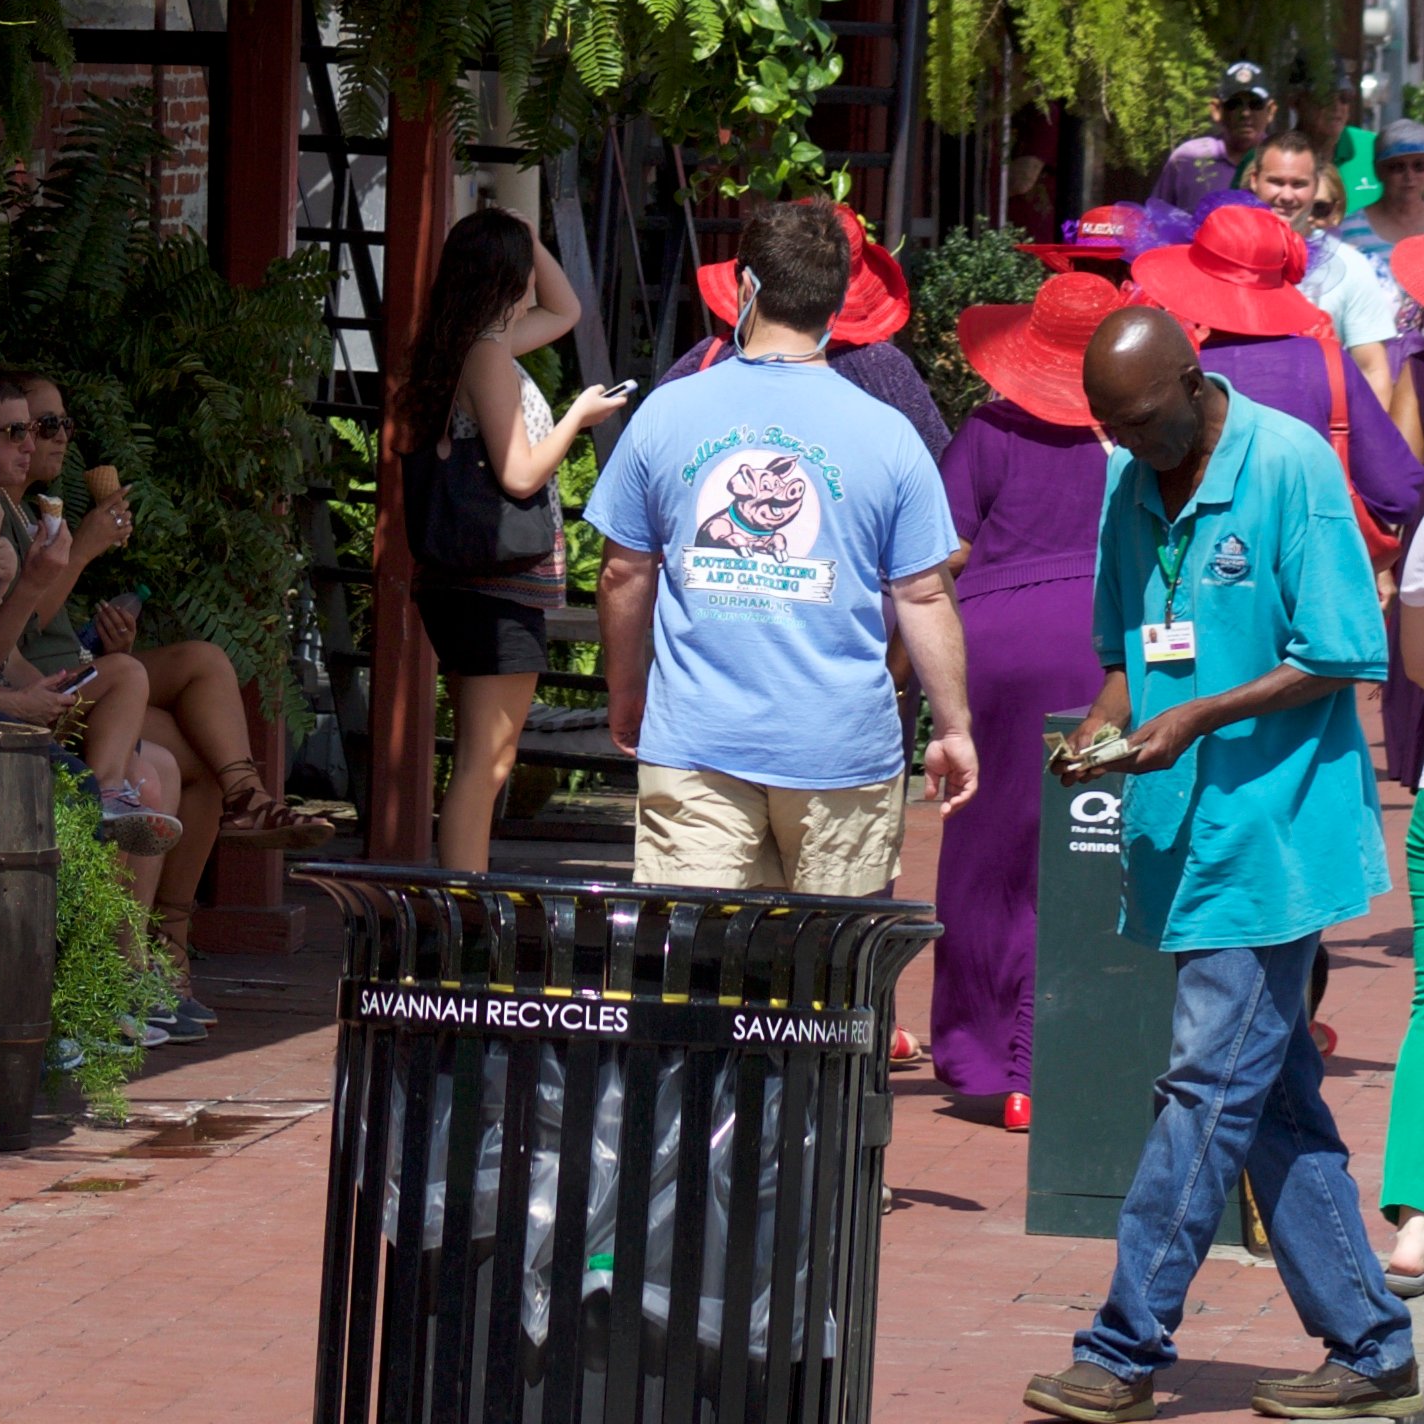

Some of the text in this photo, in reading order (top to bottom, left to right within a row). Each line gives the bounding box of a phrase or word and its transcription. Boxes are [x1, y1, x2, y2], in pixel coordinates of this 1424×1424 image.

[692, 555, 817, 580] SOUTHERN COOKING
[706, 570, 734, 584] AND
[737, 573, 800, 593] CATERING
[708, 594, 775, 610] DURHAM,
[360, 989, 629, 1034] SAVANNAH RECYCLES
[732, 1013, 848, 1044] SAVANNAH
